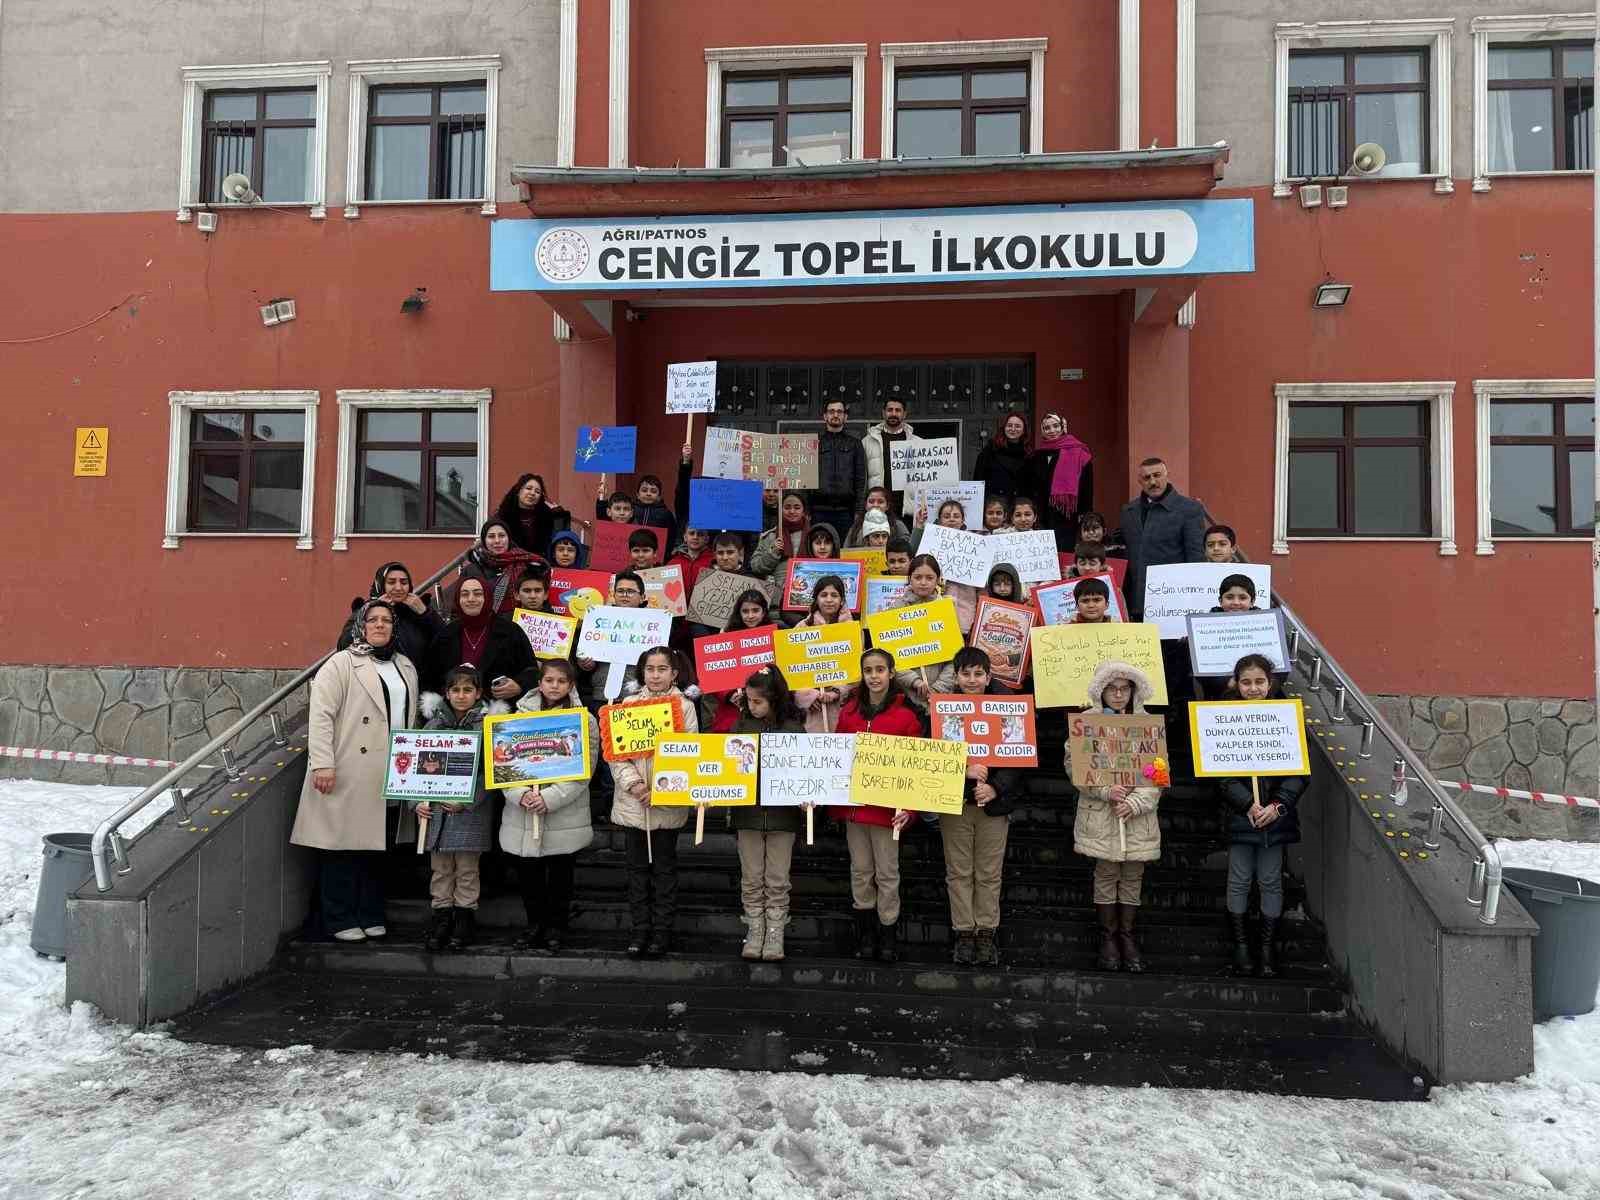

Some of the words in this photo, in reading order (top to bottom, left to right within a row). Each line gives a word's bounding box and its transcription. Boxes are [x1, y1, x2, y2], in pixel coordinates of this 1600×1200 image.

[602, 229, 707, 241] AĞRI/PATNOS
[598, 236, 761, 280] CENGİZ
[774, 239, 916, 276] TOPEL
[931, 230, 1166, 272] İLKOKULU
[898, 608, 929, 621] SELAM
[595, 616, 635, 630] SELAM
[788, 631, 820, 643] SELAM
[879, 627, 913, 641] BARIŞIN
[704, 641, 735, 653] SELAM
[807, 644, 851, 657] YAYILIRSA
[897, 643, 940, 657] ADIMIDIR
[788, 661, 837, 673] MUHABBET
[815, 671, 845, 683] ARTAR
[937, 703, 973, 713] SELAM
[984, 703, 1026, 715] BARIŞIN
[1214, 715, 1243, 724] SELAM
[1245, 713, 1280, 723] VERDİM,
[972, 724, 986, 733] VE
[1072, 719, 1118, 738] SELAM
[1205, 728, 1236, 738] DÜNYA
[415, 738, 454, 749] SELAM
[663, 743, 698, 754] SELAM
[762, 734, 798, 749] SELAM
[807, 735, 850, 752] VERMEK
[1216, 740, 1254, 749] KALPLER
[996, 745, 1033, 755] ADIDIR
[854, 751, 897, 768] ARASINDA
[1213, 753, 1253, 762] DOSTLUK
[698, 764, 719, 774] VER
[691, 785, 744, 799] GÜLÜMSE
